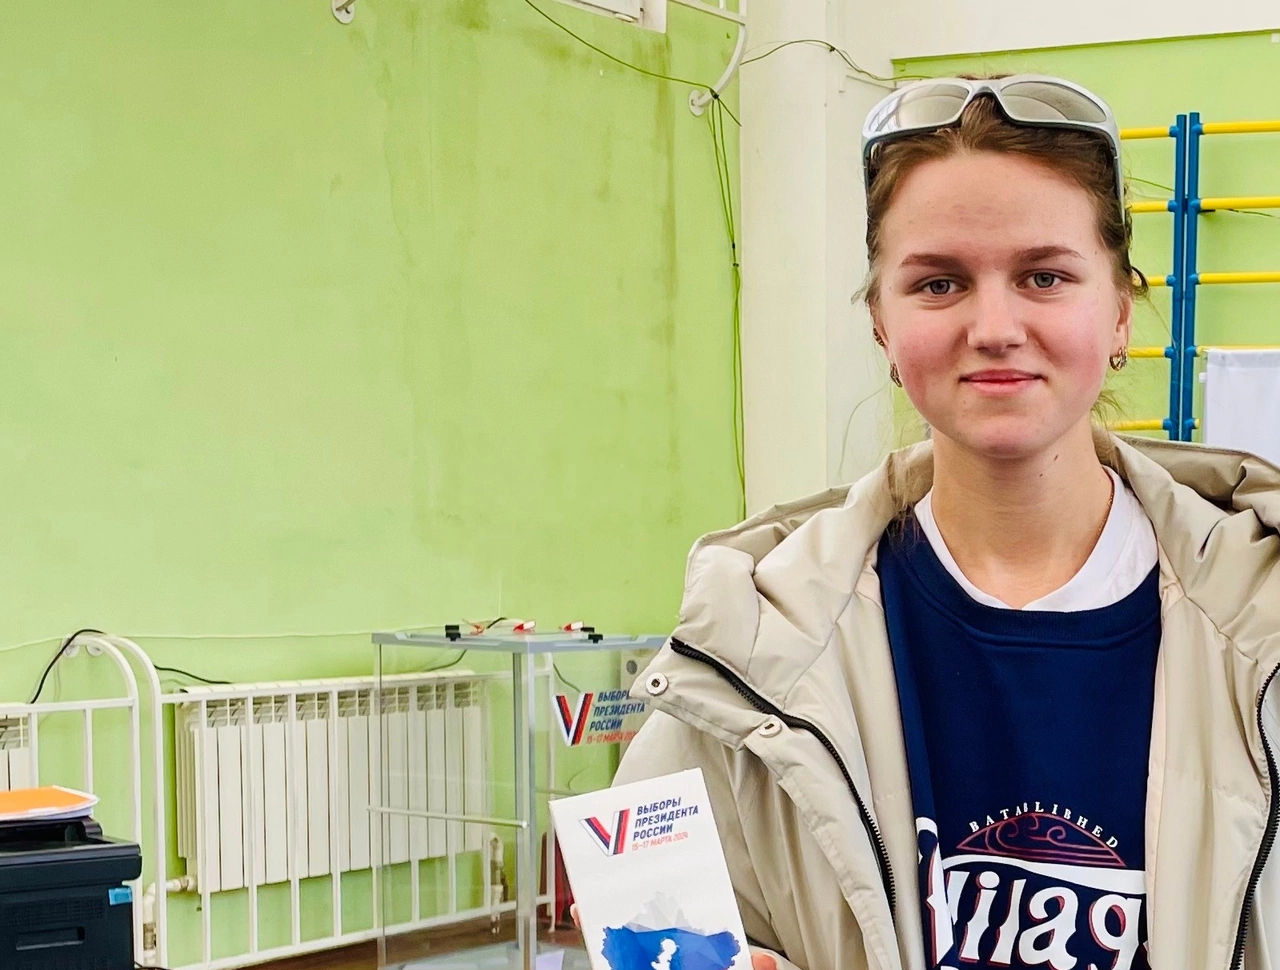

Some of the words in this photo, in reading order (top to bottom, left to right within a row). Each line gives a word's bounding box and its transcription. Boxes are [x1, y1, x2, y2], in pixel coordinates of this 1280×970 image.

[593, 703, 645, 717] ПРЕЗИДЕНТА
[589, 719, 623, 732] РОССИИ
[636, 797, 682, 816] ВЫБОРЫ
[634, 805, 699, 829] ПРЕЗИДЕНТА
[633, 823, 673, 841] РОССИИ
[650, 834, 673, 847] МАРТА
